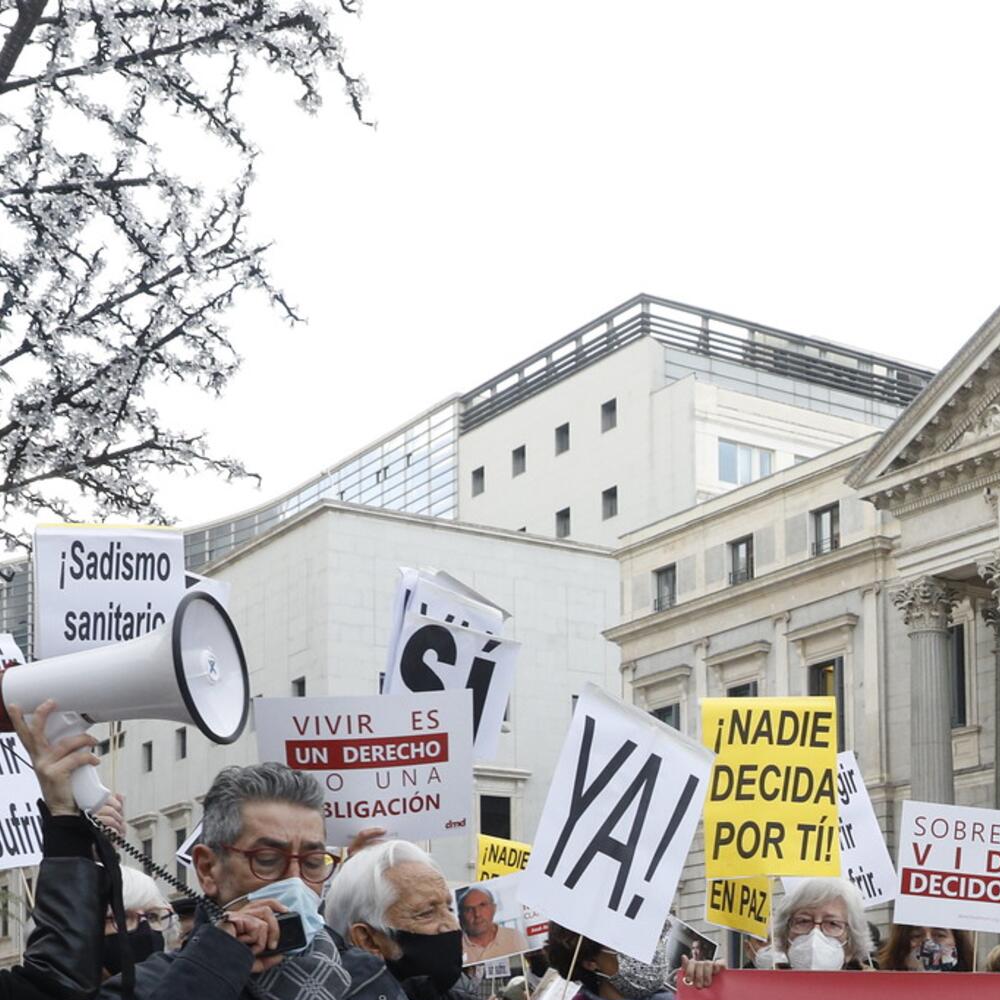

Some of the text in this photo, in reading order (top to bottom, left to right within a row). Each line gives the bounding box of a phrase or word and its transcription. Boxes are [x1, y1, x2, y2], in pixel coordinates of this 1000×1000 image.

[59, 540, 171, 590] ¡Sadismo
[292, 709, 440, 736] VIVIR ES
[713, 709, 833, 754] ¡NADIE
[295, 740, 441, 765] UN DERECHO
[326, 766, 442, 792] O UNA
[710, 763, 837, 806] DECIDA
[324, 791, 441, 819] BLIGACIÓN
[544, 715, 700, 920] YA!
[445, 817, 467, 830] dmd
[712, 816, 834, 863] POR TÍ!
[482, 843, 531, 870] ¡NADIE
[710, 880, 736, 914] EN
